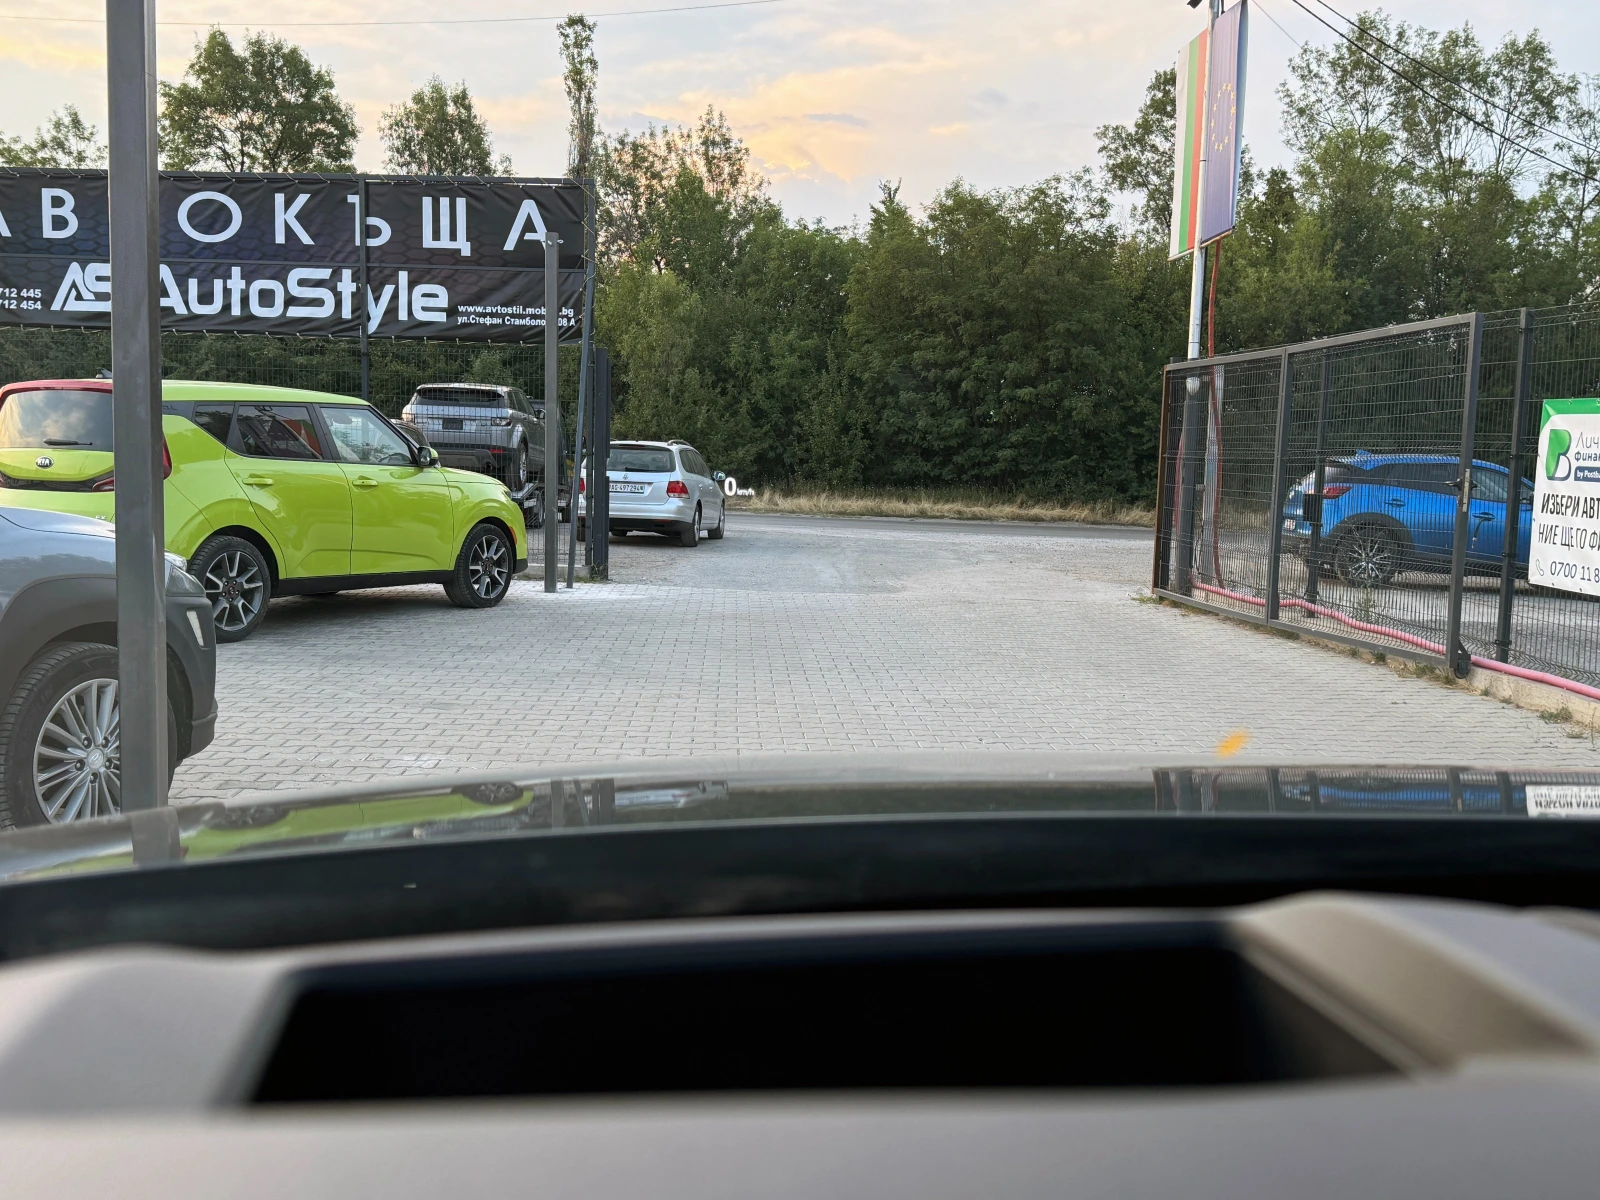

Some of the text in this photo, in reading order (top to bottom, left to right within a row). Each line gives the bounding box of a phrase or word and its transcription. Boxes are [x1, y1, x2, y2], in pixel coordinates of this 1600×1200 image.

[0, 187, 547, 257] ВОКЪЩА
[20, 288, 42, 299] 445
[159, 263, 449, 337] AutoStyle
[20, 300, 42, 310] 454
[504, 316, 546, 326] Стамболо
[1576, 469, 1584, 480] by
[724, 476, 755, 497] 0 km/h
[1541, 492, 1581, 518] ИЗБЕРИ
[1538, 522, 1559, 545] НИЕ
[1549, 560, 1578, 579] 0700
